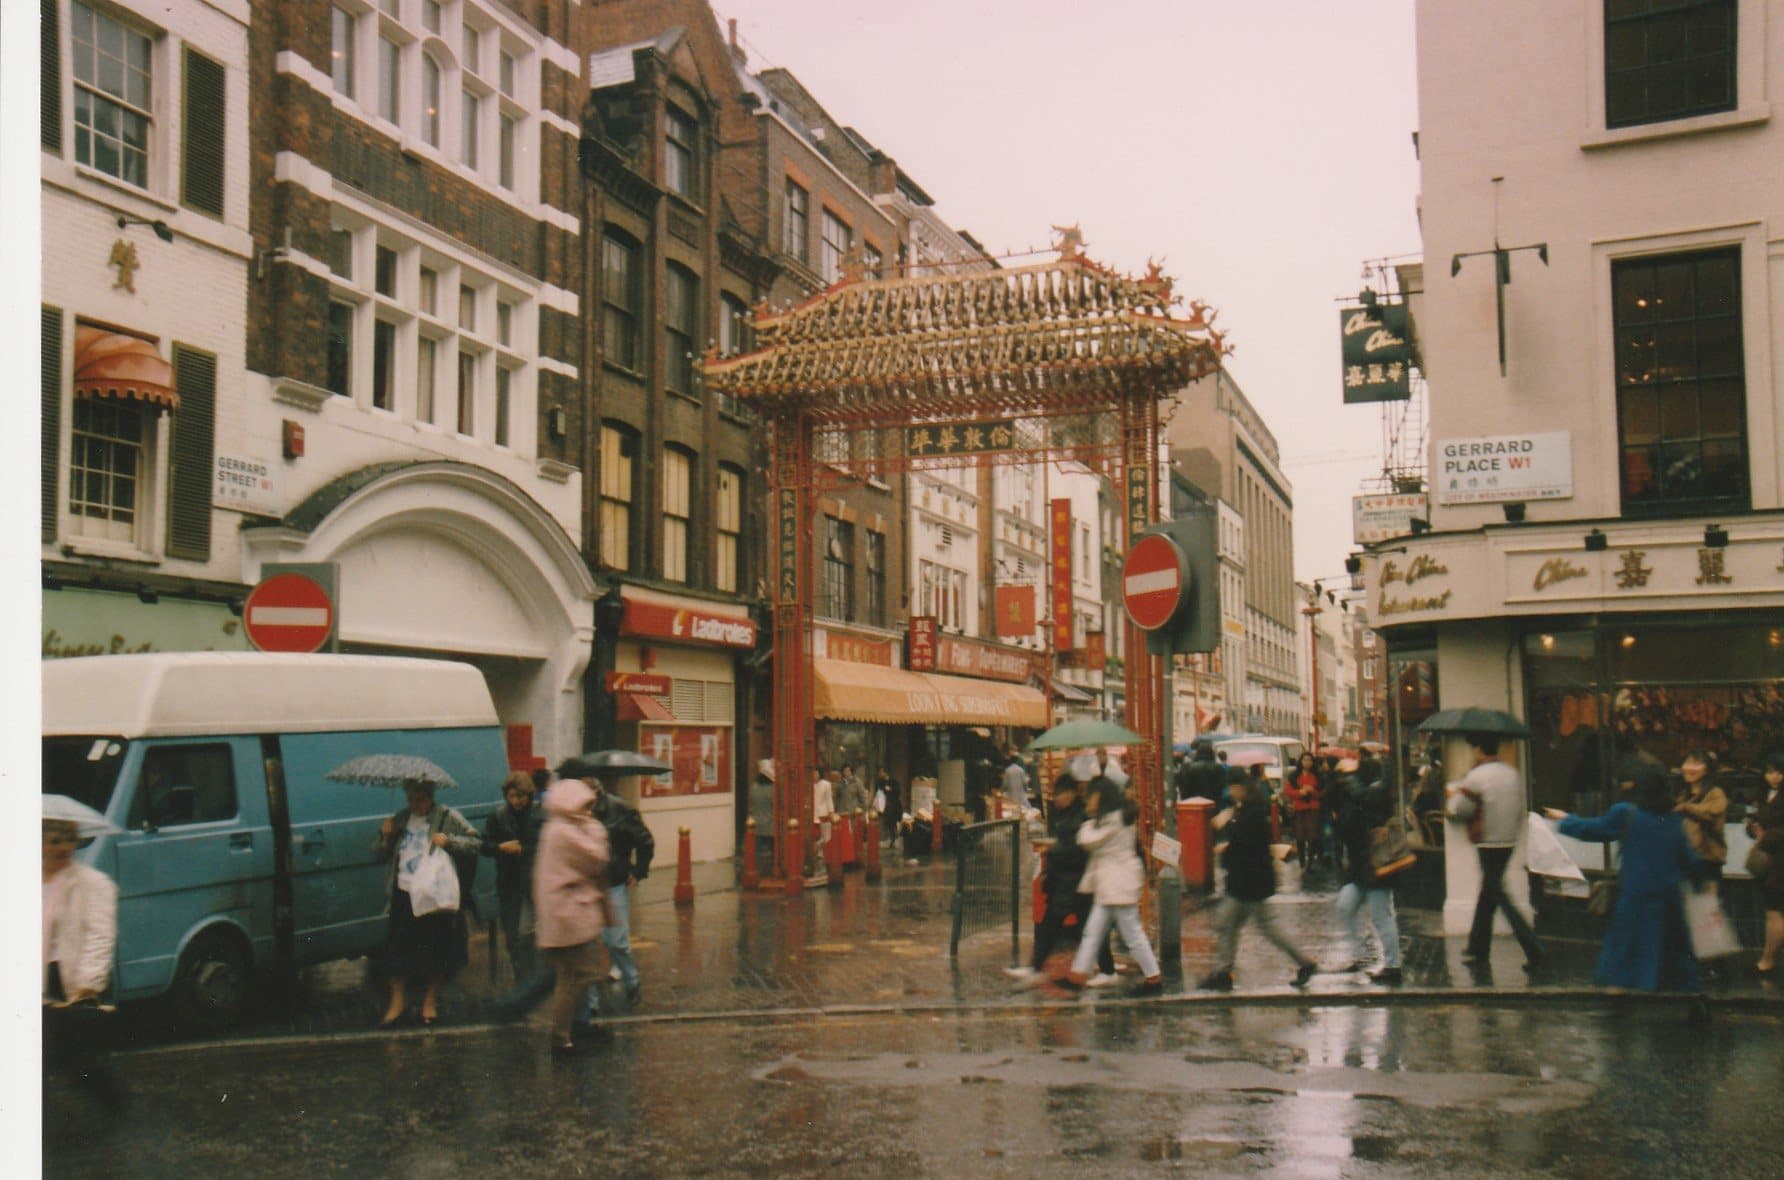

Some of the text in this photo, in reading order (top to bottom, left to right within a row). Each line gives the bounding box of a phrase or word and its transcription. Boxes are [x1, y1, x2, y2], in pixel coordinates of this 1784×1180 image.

[1445, 440, 1533, 457] GERRARD
[218, 456, 267, 476] GERRARD
[1445, 457, 1531, 473] PLACE W1
[217, 471, 257, 488] STREET
[1533, 557, 1588, 591] China
[691, 616, 753, 646] Ladbrokes
